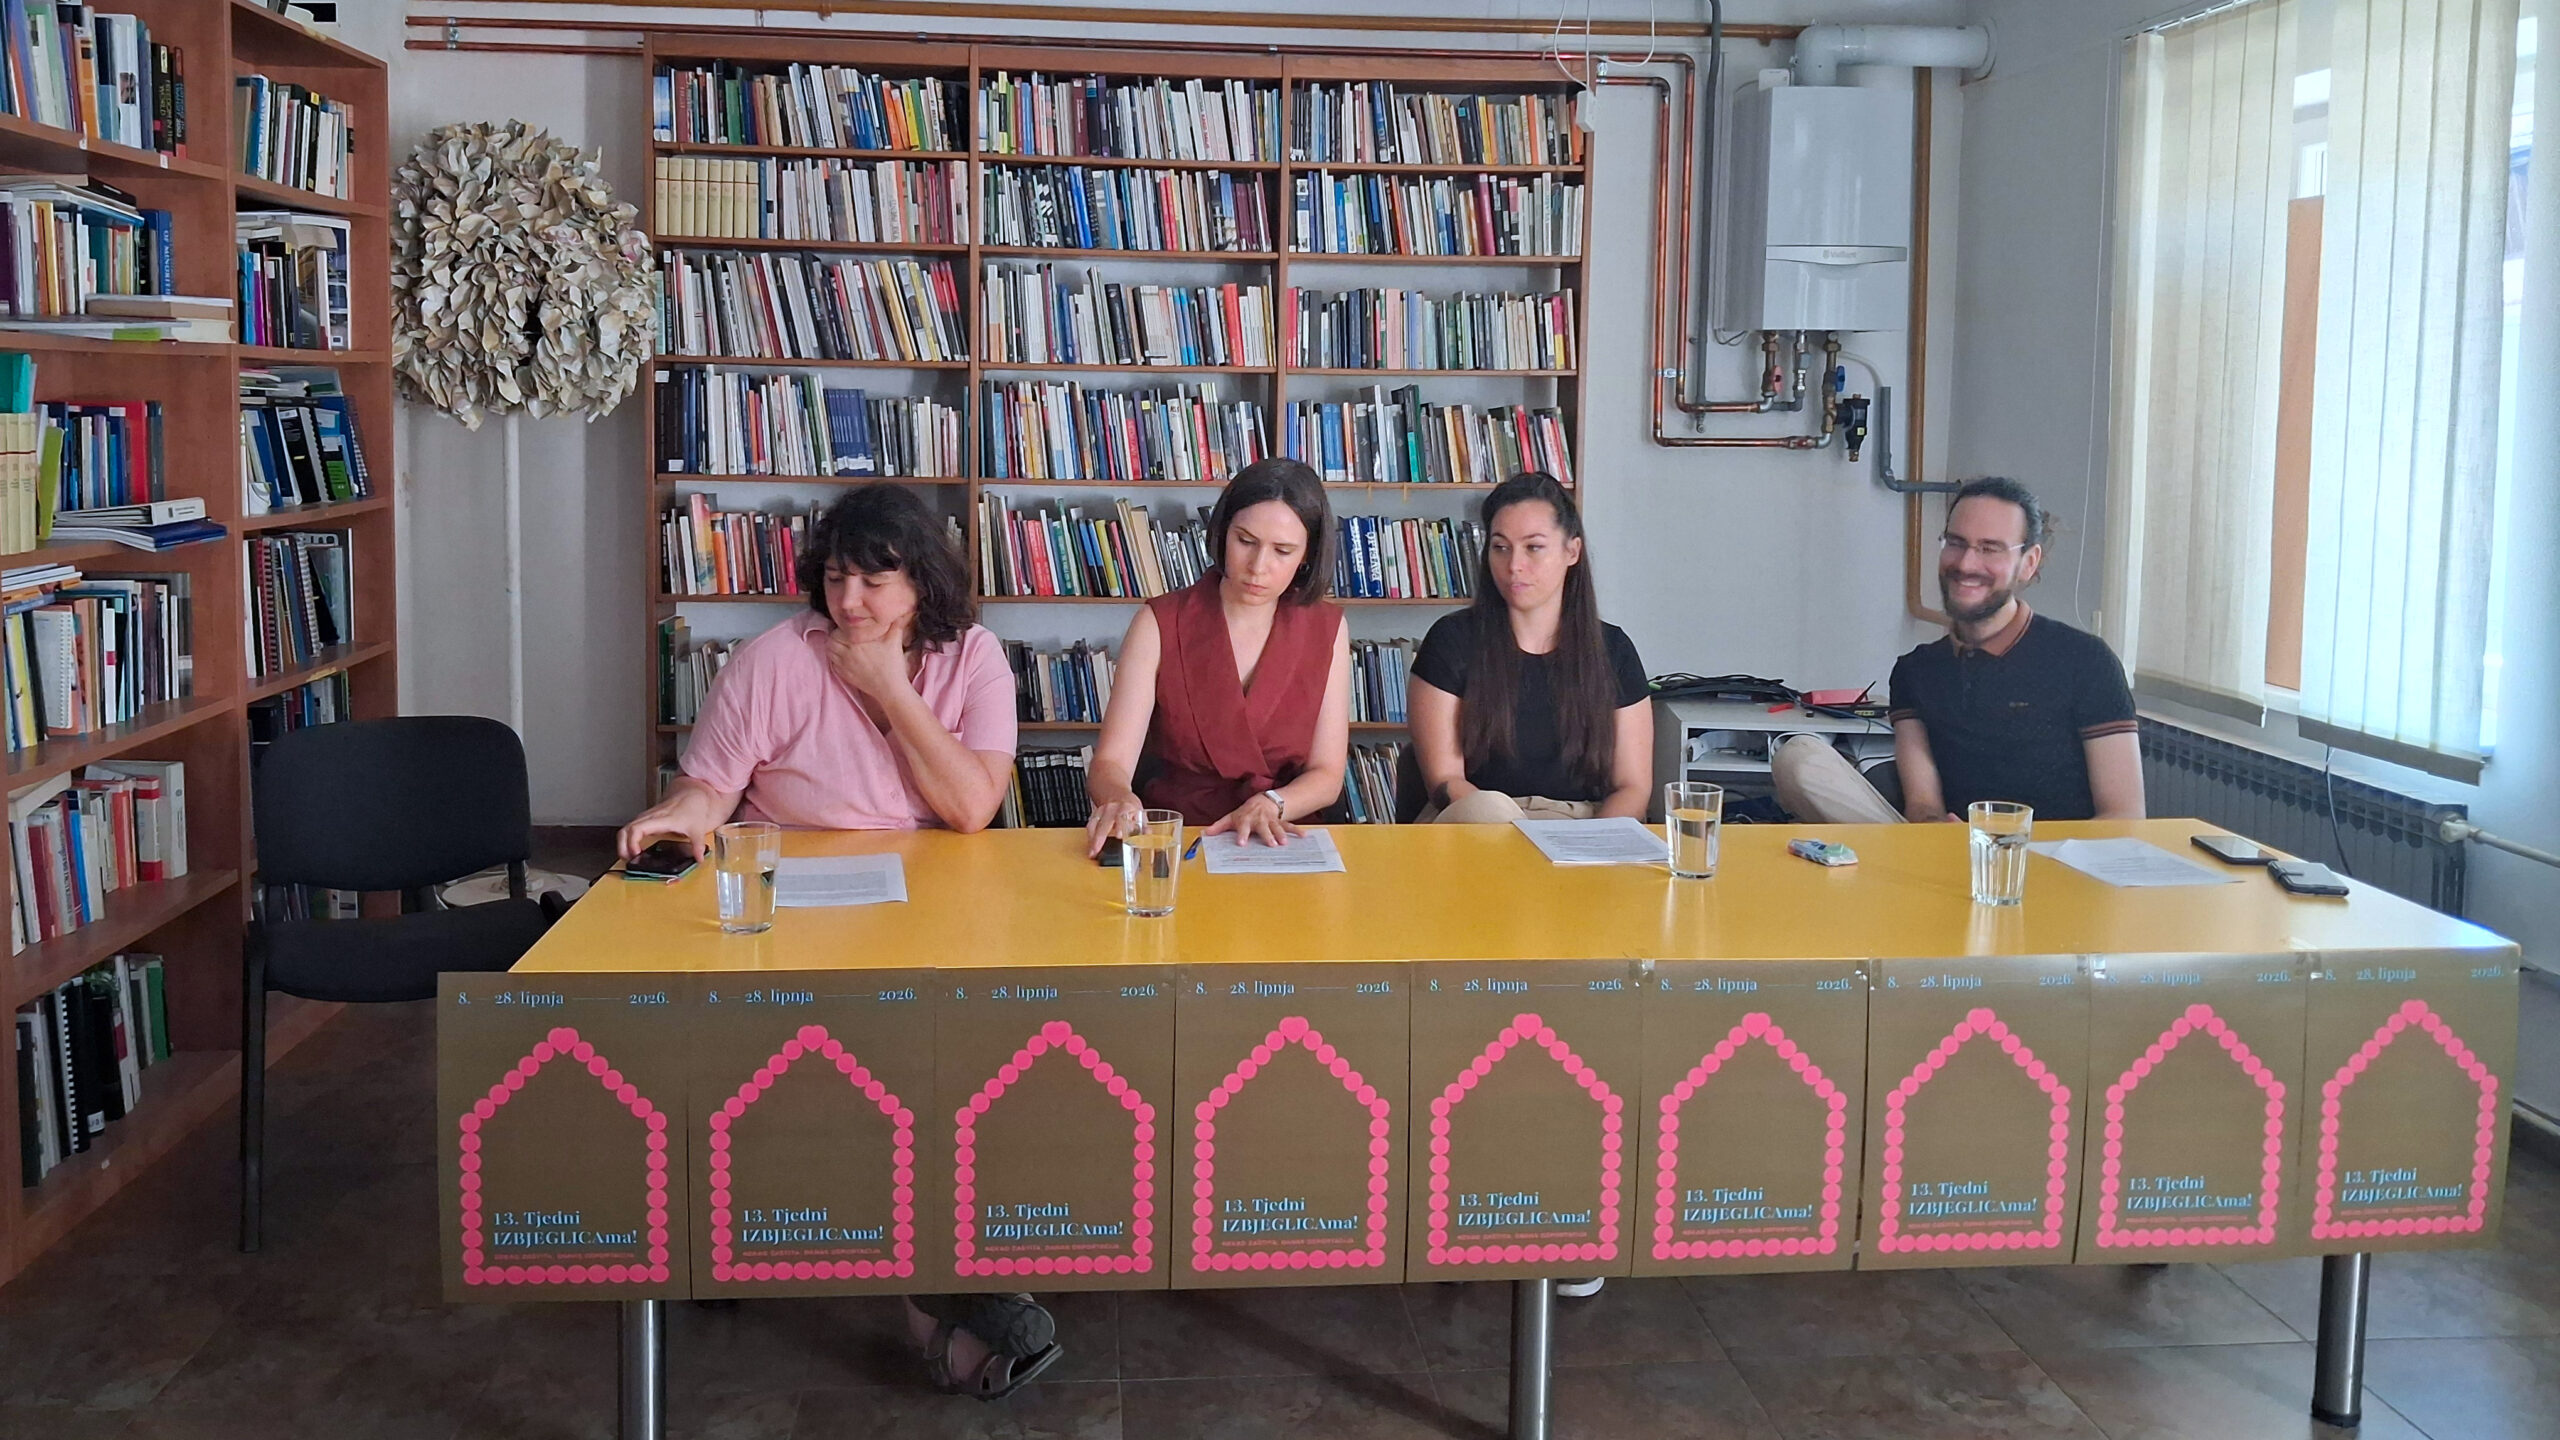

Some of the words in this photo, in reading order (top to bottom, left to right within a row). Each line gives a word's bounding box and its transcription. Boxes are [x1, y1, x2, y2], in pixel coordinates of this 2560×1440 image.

[163, 229, 170, 242] OF
[1365, 531, 1382, 582] PAVELIĆ
[1888, 976, 1900, 988] 8.
[1920, 975, 1939, 988] 28.
[1943, 974, 1982, 990] lipnja
[2039, 974, 2075, 986] 2026.
[2256, 970, 2291, 982] 2026.
[956, 987, 969, 1000] 8.
[991, 986, 1011, 999] 28.
[1016, 985, 1058, 1001] lipnja
[1120, 984, 1158, 997] 2026.
[1195, 982, 1208, 995] 8.
[1230, 981, 1249, 995] 28.
[1254, 980, 1295, 997] lipnja
[1356, 981, 1393, 993] 2026.
[1430, 979, 1442, 992] 8.
[1464, 979, 1483, 991] 28.
[1487, 978, 1528, 994] lipnja
[1588, 979, 1625, 991] 2026.
[1660, 978, 1673, 991] 8.
[1694, 978, 1713, 991] 28.
[1718, 977, 1757, 994] lipnja
[1816, 978, 1852, 990] 2026.
[458, 992, 471, 1005] 8.
[495, 992, 516, 1005] 28.
[521, 991, 565, 1007] lipnja
[629, 992, 669, 1004] 2026.
[708, 991, 721, 1003] 8.
[745, 990, 766, 1003] 28.
[771, 988, 814, 1006] lipnja
[878, 987, 917, 1001] 2026.
[2129, 1178, 2151, 1191] 13.
[2155, 1176, 2205, 1193] Tjedni
[2344, 1171, 2365, 1184] 13.
[2370, 1167, 2417, 1185] Tjedni
[1686, 1189, 1708, 1203] 13.
[1712, 1187, 1764, 1205] Tjedni
[1911, 1183, 1933, 1197] 13.
[1937, 1180, 1988, 1198] Tjedni
[2341, 1183, 2463, 1205] IZBJEGLICAma!
[1225, 1200, 1247, 1213] 13.
[1252, 1197, 1305, 1215] Tjedni
[1459, 1194, 1482, 1207] 13.
[1487, 1191, 1539, 1209] Tjedni
[1909, 1198, 2037, 1217] IZBJEGLICAma!
[2127, 1193, 2253, 1212] IZBJEGLICAma!
[494, 1212, 519, 1225] 13.
[523, 1210, 581, 1228] Tjedni
[743, 1210, 767, 1223] 13.
[772, 1207, 828, 1225] Tjedni
[986, 1205, 1009, 1218] 13.
[1015, 1203, 1069, 1220] Tjedni
[1457, 1209, 1591, 1229] IZBJEGLICAma!
[1684, 1204, 1813, 1224] IZBJEGLICAma!
[985, 1221, 1124, 1240] IZBJEGLICAma!
[1222, 1216, 1358, 1235] IZBJEGLICAma!
[494, 1230, 638, 1248] IZBJEGLICAma!
[742, 1225, 884, 1245] IZBJEGLICAma!
